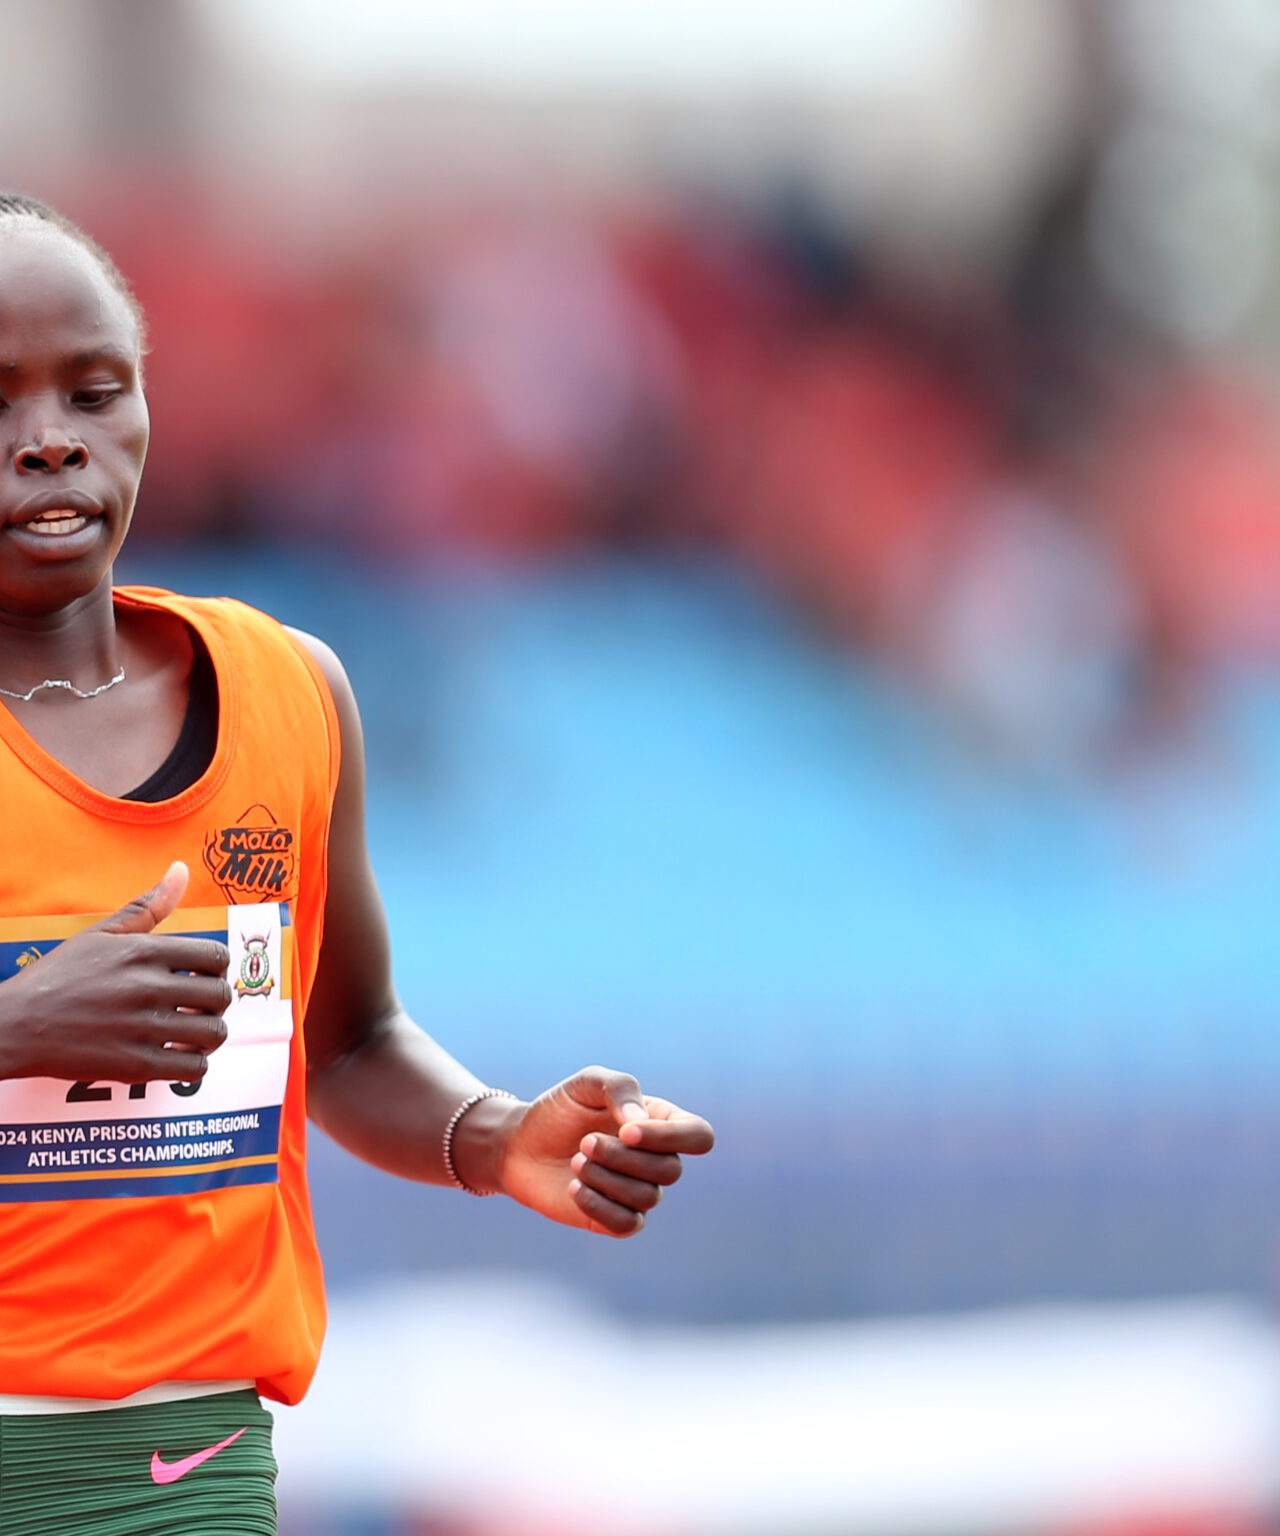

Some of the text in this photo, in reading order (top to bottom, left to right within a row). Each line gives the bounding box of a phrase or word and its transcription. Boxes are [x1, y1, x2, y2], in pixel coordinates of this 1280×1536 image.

[218, 852, 287, 892] Milk
[31, 1127, 86, 1145] KENYA
[89, 1123, 162, 1142] PRISONS
[164, 1113, 260, 1138] INTER-REGIONAL
[27, 1138, 234, 1168] ATHLETICS CHAMPIONSHIPS.
